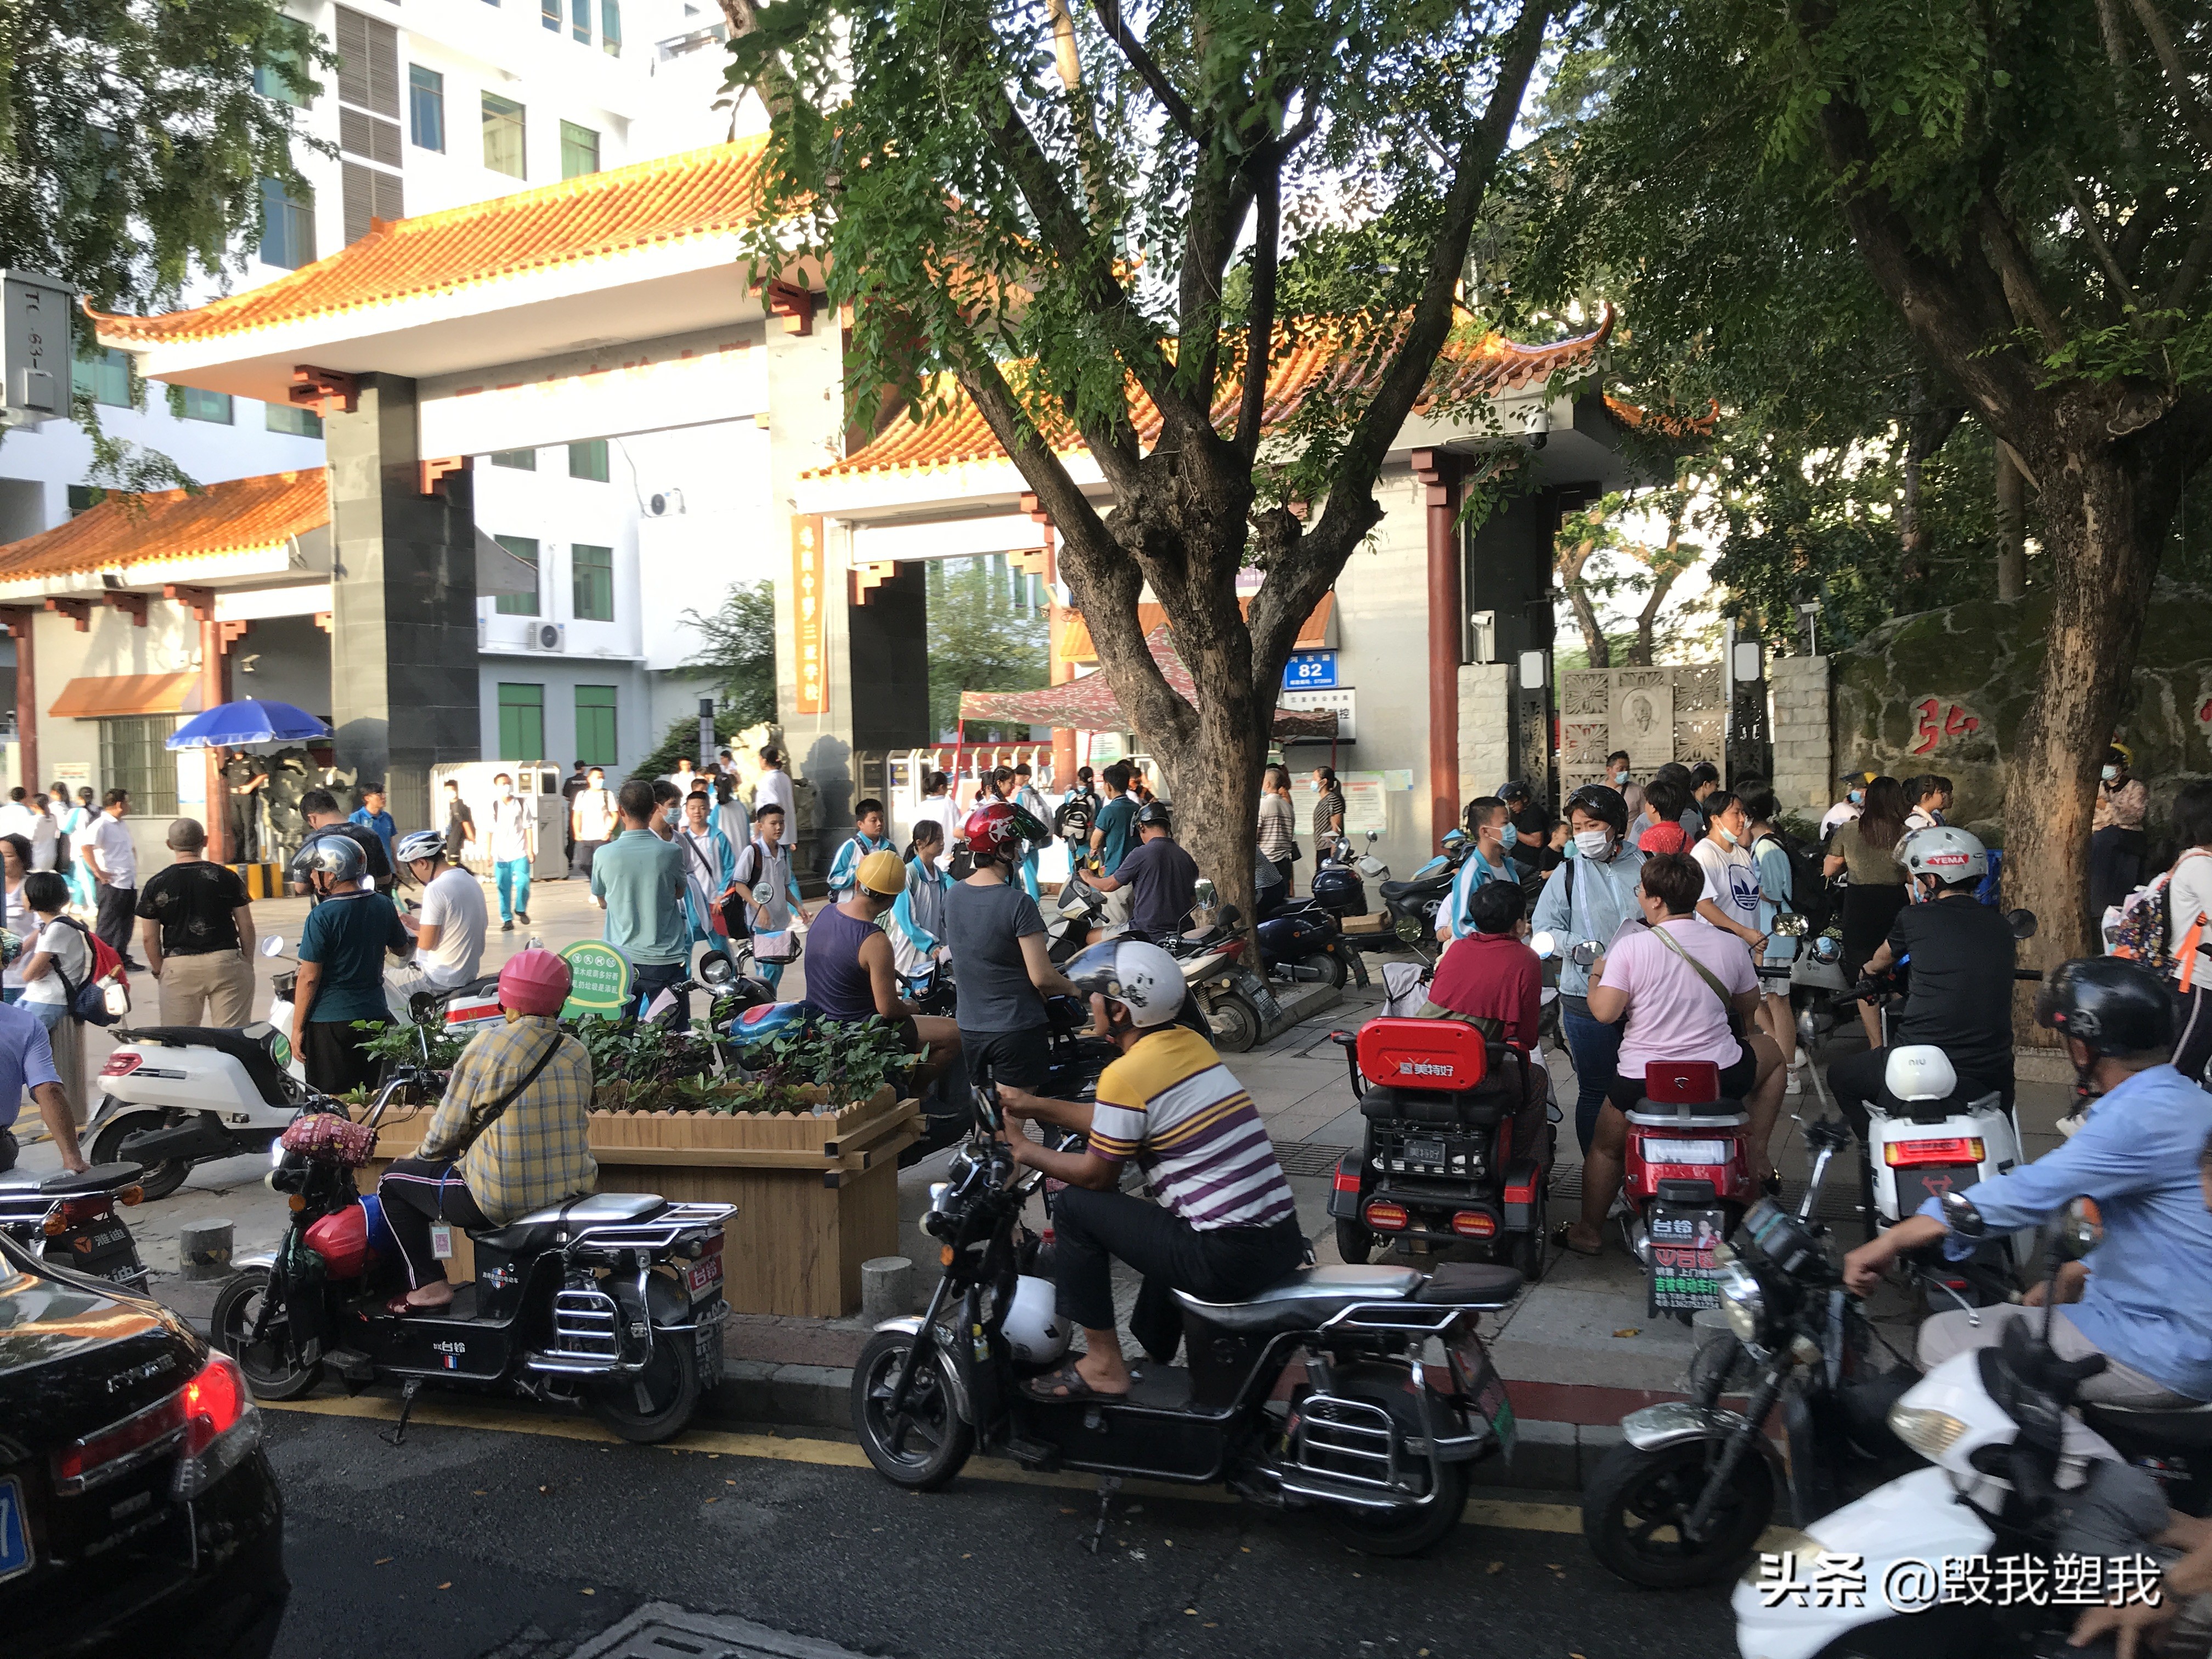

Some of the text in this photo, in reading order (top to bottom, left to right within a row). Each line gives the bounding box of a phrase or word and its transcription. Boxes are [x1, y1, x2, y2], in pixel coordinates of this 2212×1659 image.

[1299, 663, 1322, 677] 82
[1414, 1063, 1454, 1077] 美特好
[1653, 1218, 1693, 1233] 台铃
[93, 1228, 126, 1247] 雅迪
